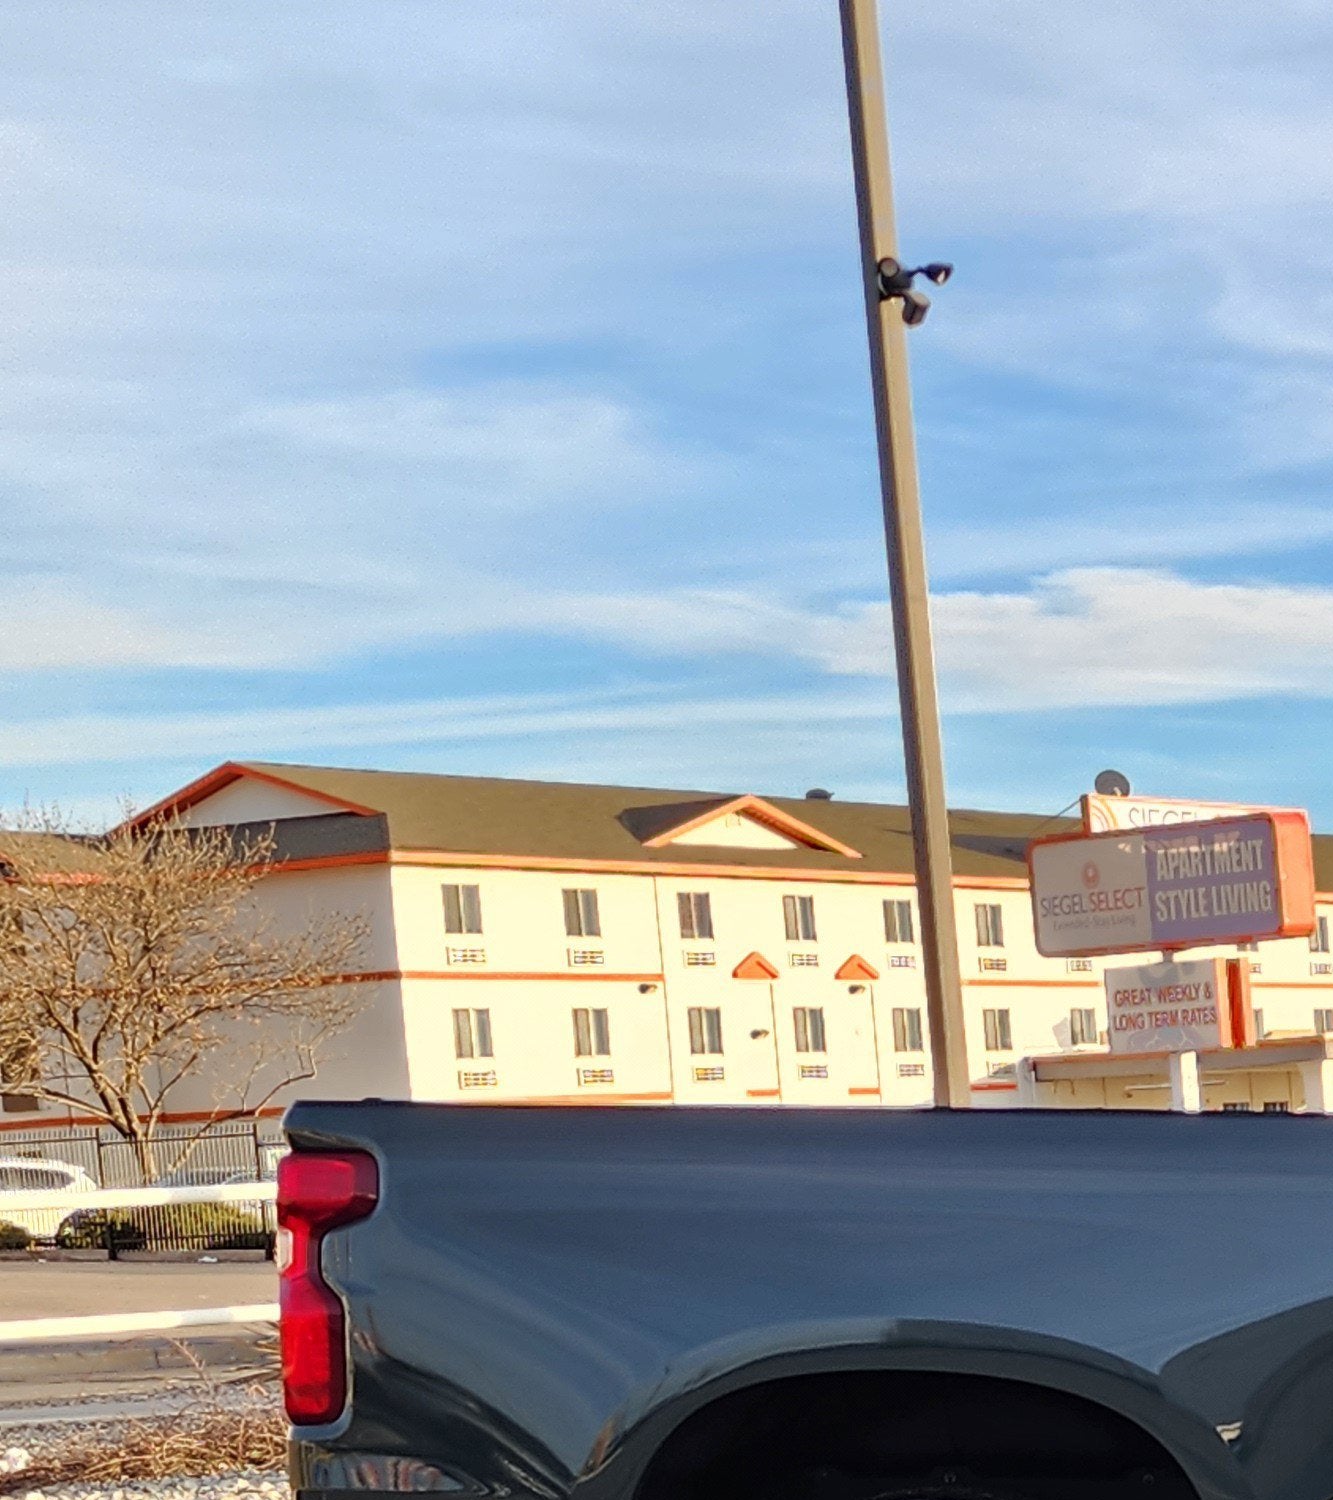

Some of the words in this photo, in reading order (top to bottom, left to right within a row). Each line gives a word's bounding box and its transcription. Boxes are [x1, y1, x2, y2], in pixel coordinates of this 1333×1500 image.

[1156, 839, 1263, 881] APARTMENT
[1040, 893, 1088, 918] SIEGEL
[1088, 886, 1146, 912] SELECT
[1155, 886, 1207, 922] STYLE
[1211, 880, 1273, 916] LIVING
[1114, 987, 1153, 1007] GREAT
[1158, 983, 1201, 1003] WEEKLY
[1203, 981, 1211, 999] &
[1113, 1012, 1146, 1031] LONG
[1147, 1009, 1179, 1027] TERM
[1181, 1007, 1217, 1026] RATES
